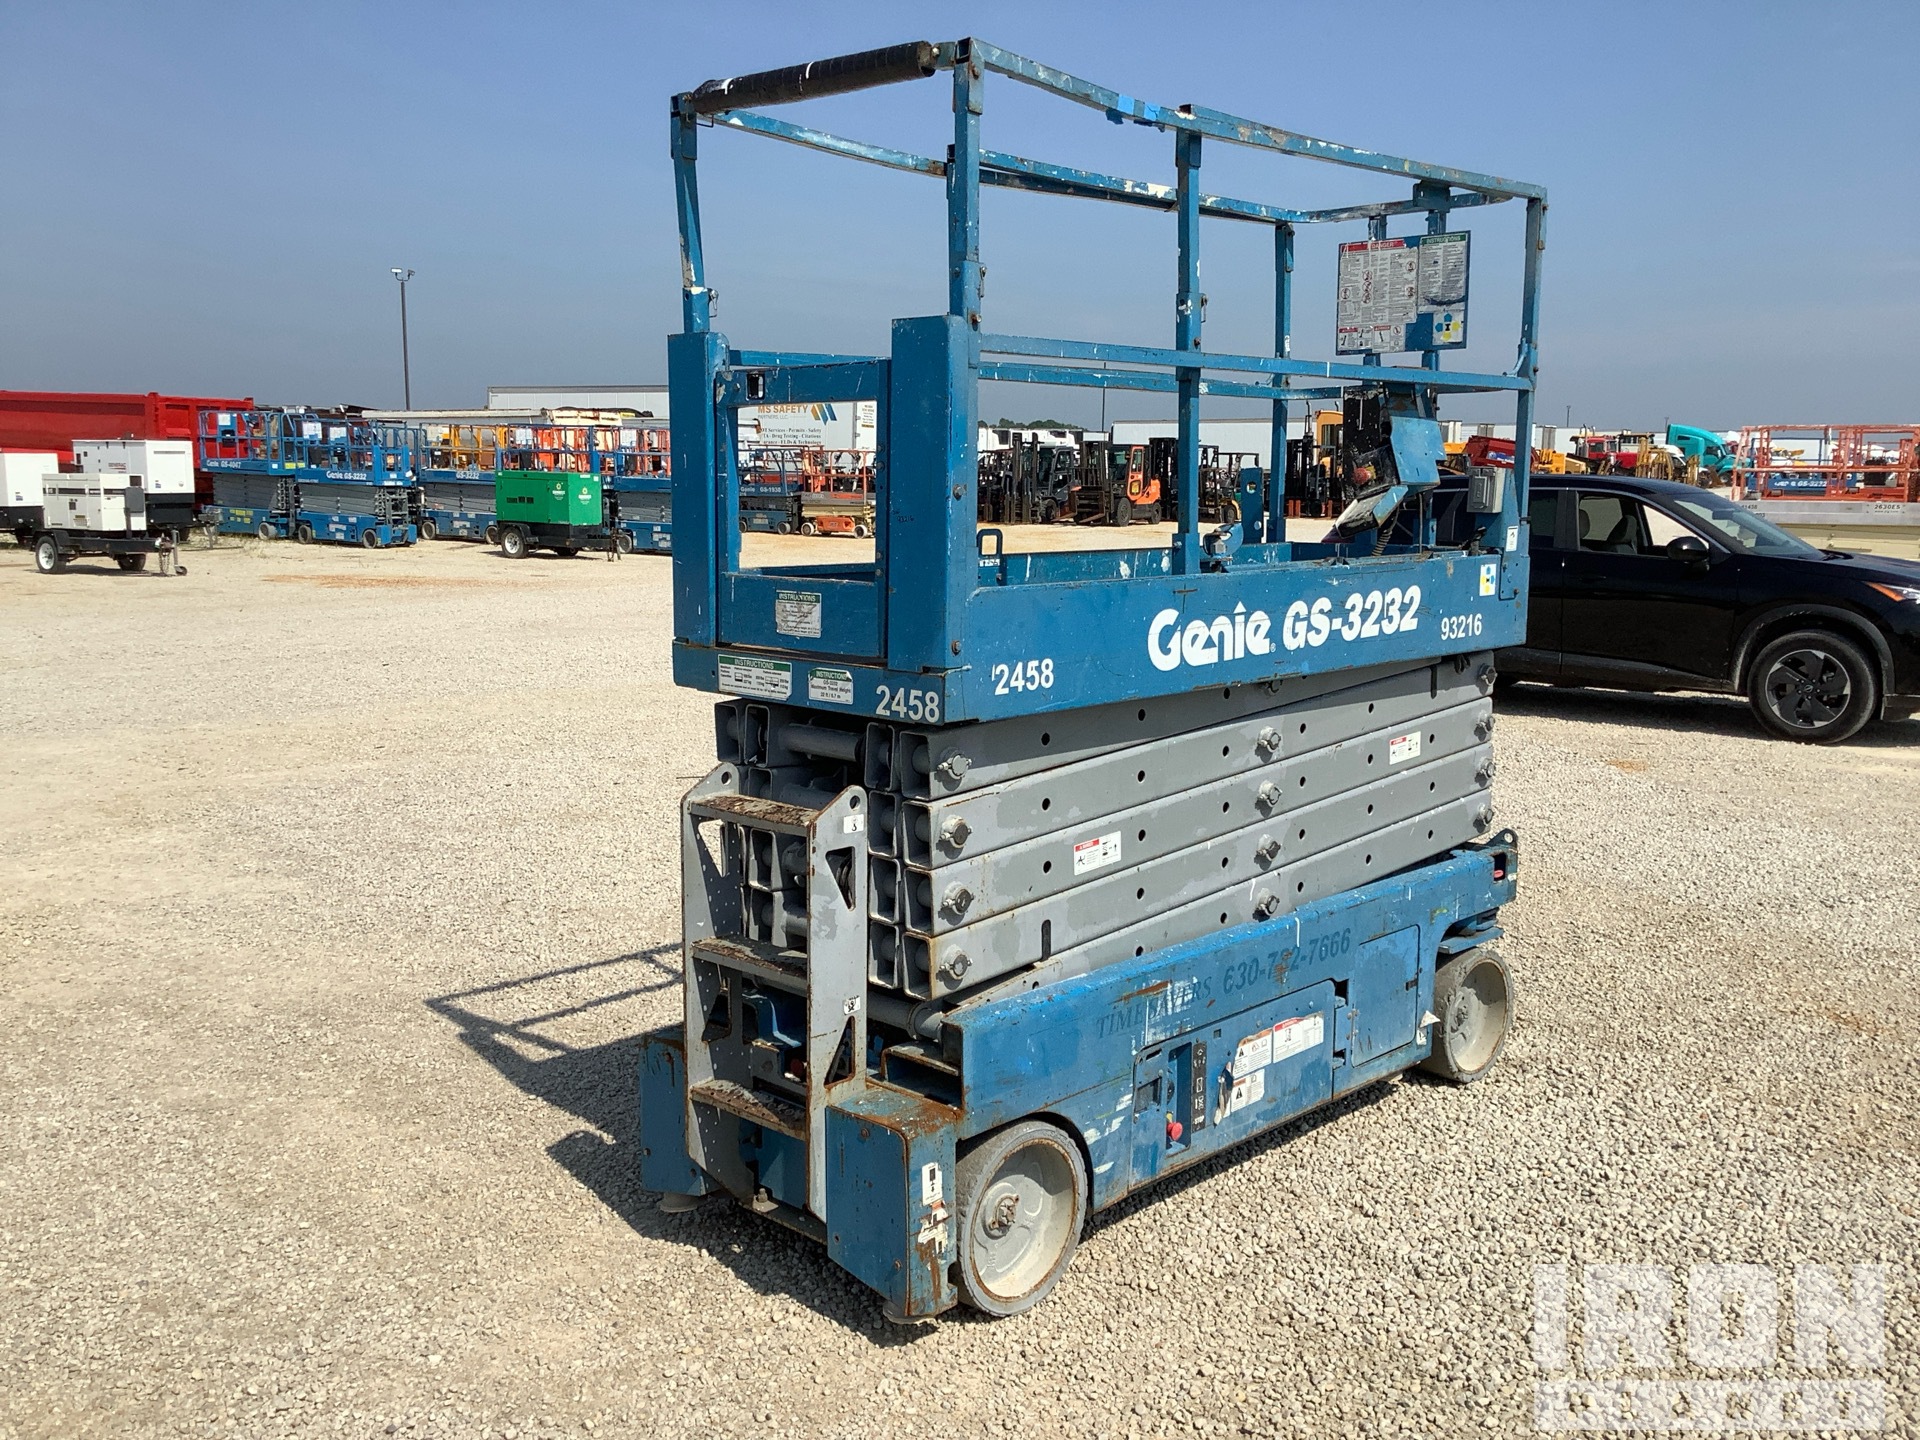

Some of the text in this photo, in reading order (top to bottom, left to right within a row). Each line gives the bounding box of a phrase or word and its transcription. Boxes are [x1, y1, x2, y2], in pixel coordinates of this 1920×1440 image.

[757, 404, 808, 414] MS SAFETY
[326, 471, 343, 479] Genie
[1148, 585, 1421, 671] Genie GS-3232
[1441, 614, 1482, 641] 93216
[735, 659, 774, 669] INSTRUCTIONS
[994, 658, 1055, 696] 2458
[876, 685, 940, 723] 2458
